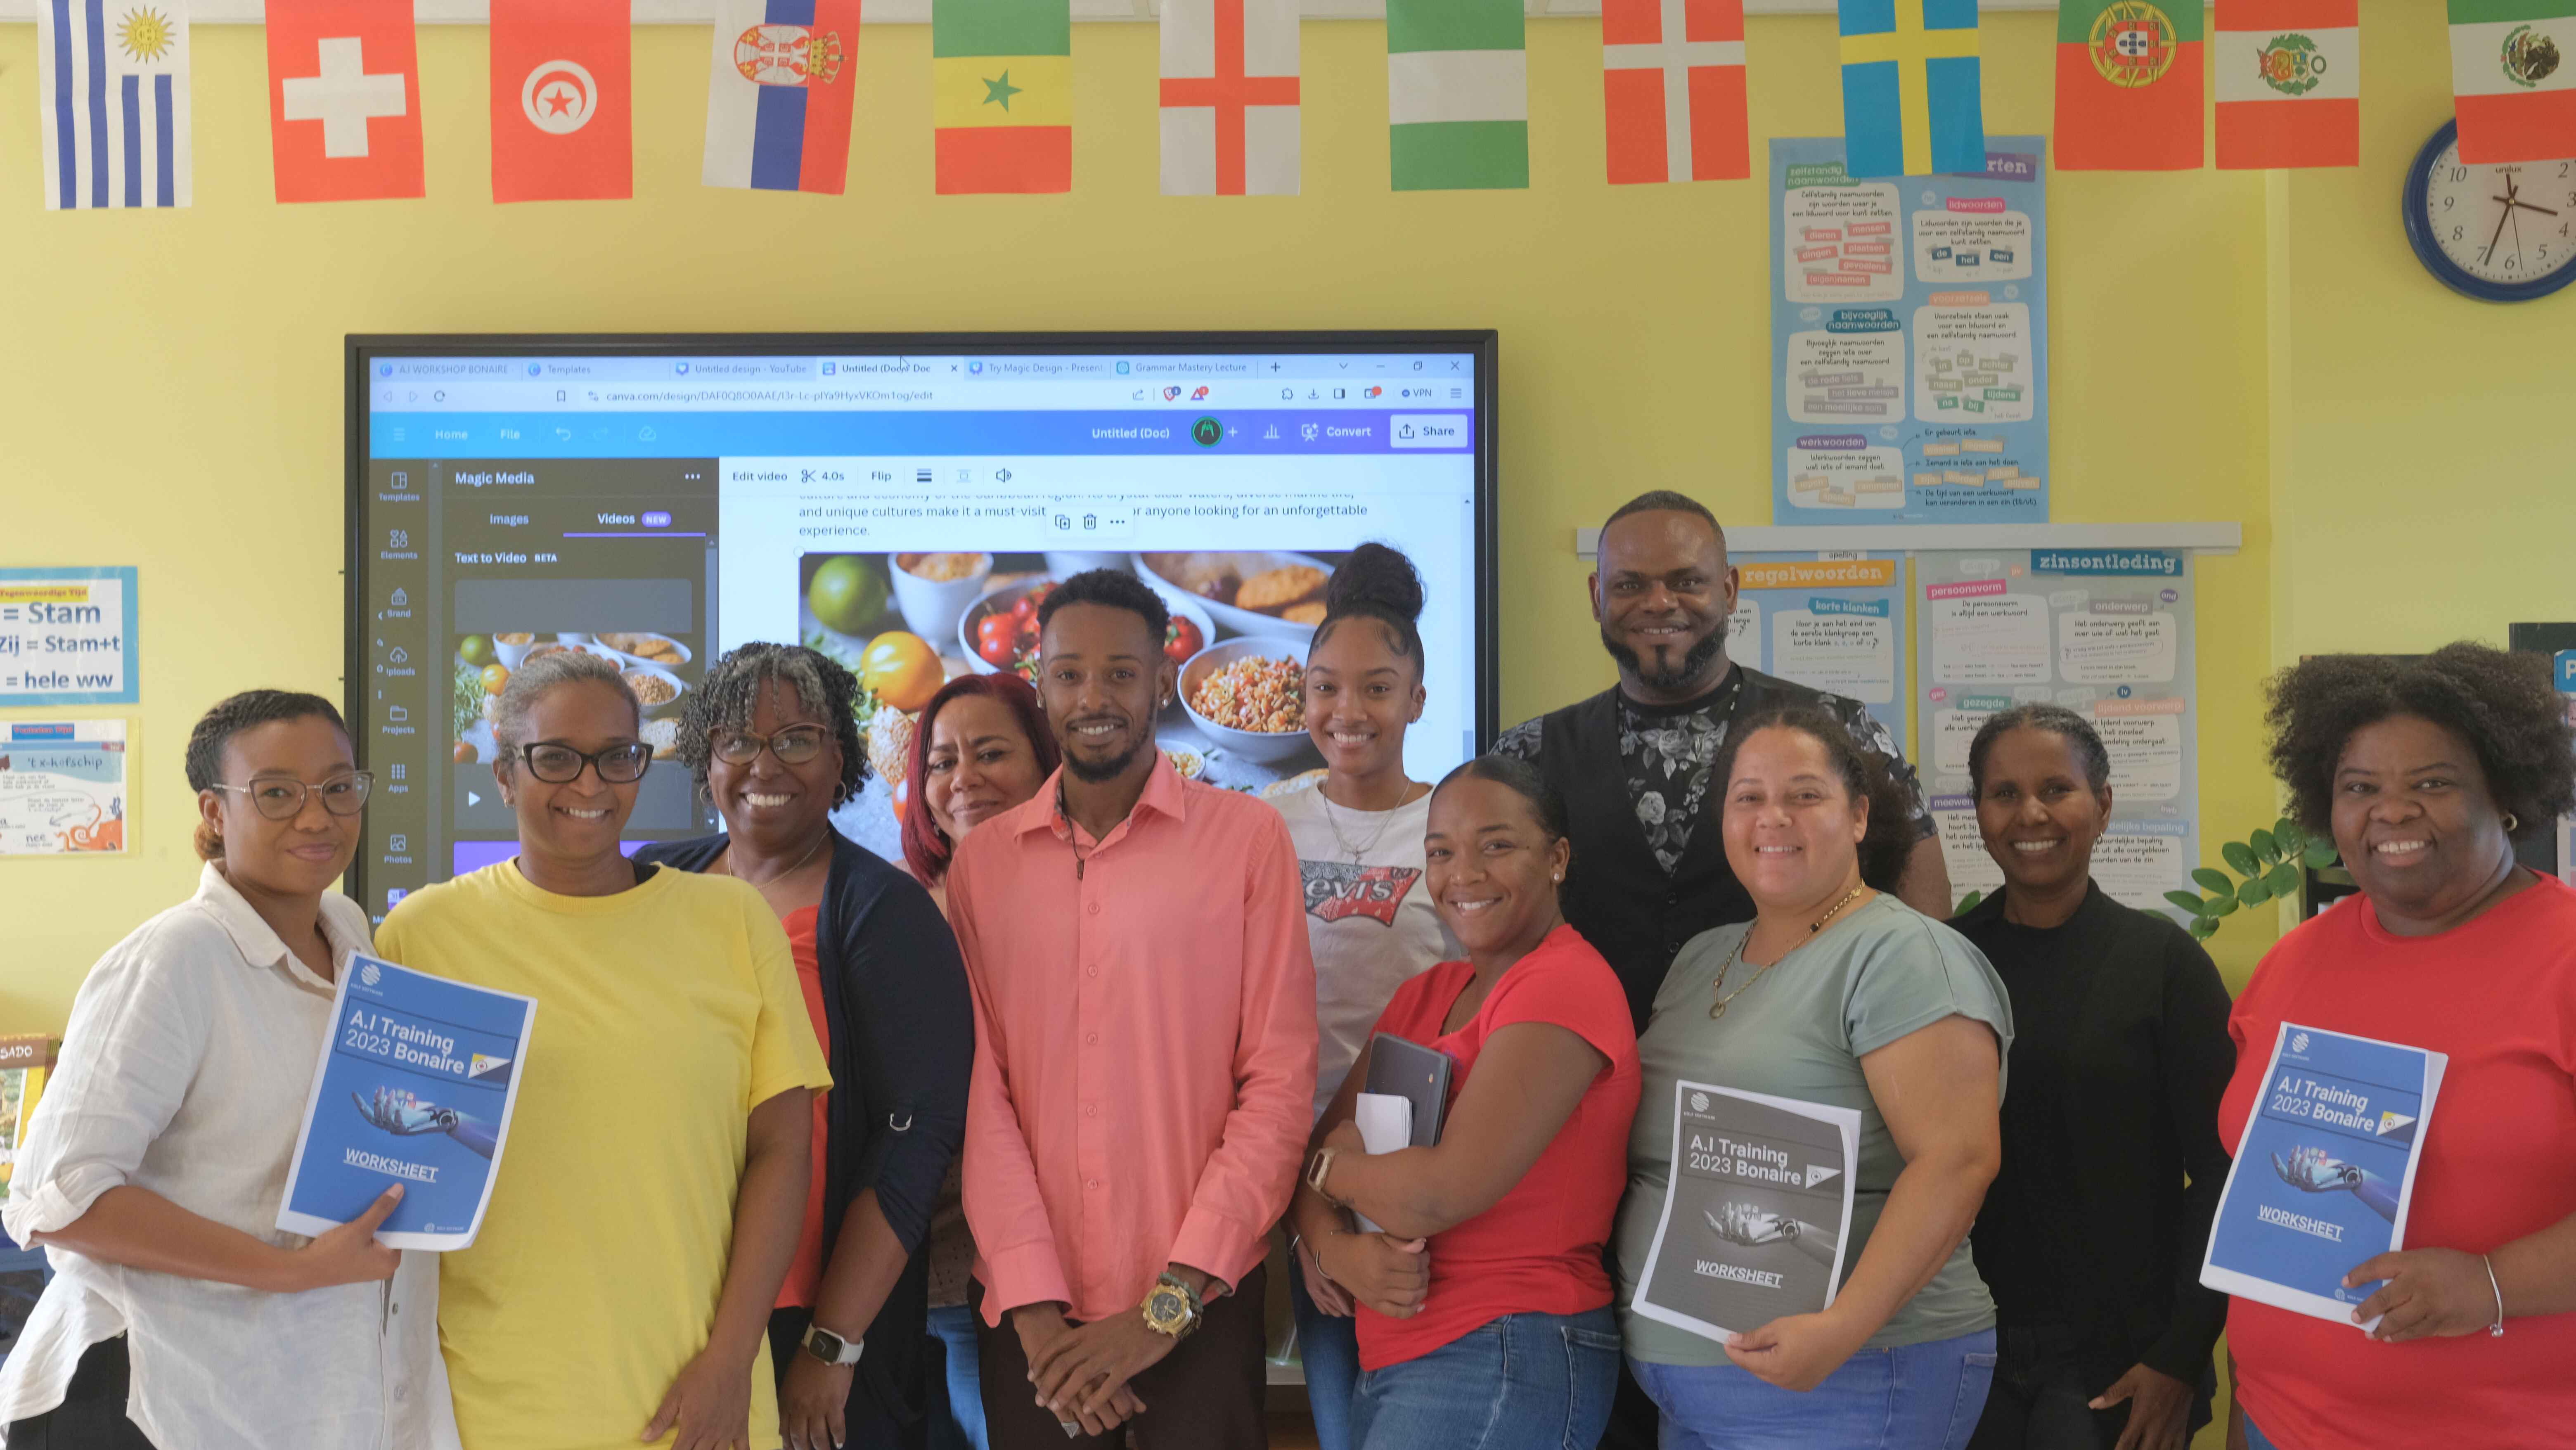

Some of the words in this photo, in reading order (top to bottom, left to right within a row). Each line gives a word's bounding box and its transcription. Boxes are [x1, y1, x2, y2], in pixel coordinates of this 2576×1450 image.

[1790, 165, 1842, 177] zelfstandig
[1987, 158, 2027, 174] rten
[2495, 165, 2522, 174] unilux
[2558, 162, 2569, 178] 2
[2449, 166, 2467, 182] 10
[1949, 199, 2003, 208] lidwoorden
[2444, 196, 2454, 212] 9
[2567, 191, 2576, 208] 3
[1853, 224, 1885, 233] mensen
[2452, 225, 2463, 241] 8
[2559, 222, 2569, 237] 4
[1802, 249, 1831, 259] dingen
[1849, 244, 1884, 252] plaatsen
[2477, 246, 2488, 262] 7
[2536, 244, 2548, 260] 5
[1994, 253, 2009, 261] een
[2504, 254, 2515, 270] 6
[1844, 262, 1886, 271] gevoelens
[1842, 311, 1888, 321] bijvoeglijk
[1829, 320, 1899, 329] naamwoorden
[413, 365, 466, 374] WORKSHOP
[469, 365, 507, 374] BONAIRE
[548, 365, 591, 375] Templates
[696, 364, 729, 374] Untitled
[732, 365, 760, 375] design
[770, 364, 806, 373] YouTube
[843, 364, 877, 373] Untitled
[914, 364, 930, 373] Doc
[990, 364, 1002, 374] Try
[1004, 364, 1030, 374] Magic
[1033, 364, 1062, 374] Design
[1136, 363, 1175, 372] Grammar
[1179, 363, 1212, 374] Mastery
[1215, 363, 1246, 372] Lecture
[1413, 388, 1432, 398] VPN
[1988, 391, 2016, 400] tijdens
[435, 430, 468, 440] Home
[500, 430, 520, 440] File
[1092, 428, 1138, 438] Untitled
[1140, 429, 1170, 440] (Doc)
[1326, 427, 1371, 437] Convert
[1423, 426, 1454, 436] Share
[1800, 438, 1864, 447] werkwoorden
[455, 472, 492, 487] Magic
[496, 472, 534, 484] Media
[733, 471, 754, 481] Edit
[757, 471, 788, 481] video
[822, 471, 844, 481] 4.0s
[871, 471, 891, 483] Flip
[379, 493, 420, 502] Templates
[799, 506, 822, 517] and
[826, 506, 868, 520] unique
[872, 506, 923, 517] cultures
[927, 506, 959, 517] make
[963, 507, 970, 517] it
[1146, 507, 1191, 519] anyone
[1194, 505, 1238, 519] looking
[1243, 505, 1259, 516] for
[1264, 507, 1278, 516] an
[1283, 505, 1367, 519] unforgettable
[490, 514, 529, 526] Images
[597, 513, 635, 524] Videos
[799, 525, 870, 538] experience.
[455, 553, 478, 563] Text
[481, 554, 492, 563] to
[495, 553, 527, 563] Video
[535, 554, 557, 562] BETA
[1829, 551, 1858, 561] spelling
[2040, 554, 2176, 573] zinsontleding
[1745, 566, 1883, 585] regelwoorden
[1932, 583, 2002, 597] persoonsvorm
[2162, 591, 2176, 601] ond
[28, 601, 101, 624] Stam
[1816, 600, 1840, 611] korte
[1843, 602, 1880, 614] klanken
[2095, 602, 2148, 613] onderwerp
[45, 634, 121, 653] Stam+t
[25, 670, 69, 689] hele
[76, 674, 114, 688] ww
[1963, 698, 2005, 708] gezegde
[382, 725, 415, 735] Projects
[388, 784, 409, 793] Apps
[2143, 821, 2184, 833] bepaling
[26, 834, 46, 843] nee
[384, 855, 412, 864] Photos
[1306, 878, 1395, 901] evi's
[351, 1010, 376, 1031] A.I
[382, 1017, 455, 1056] Training
[346, 1030, 390, 1055] 2023
[394, 1042, 464, 1074] Bonaire
[2278, 1076, 2300, 1092] A.I
[2305, 1081, 2368, 1112] Training
[2272, 1094, 2310, 1116] 2023
[2312, 1104, 2375, 1132] Bonaire
[1690, 1134, 1713, 1151] A.I
[1718, 1138, 1788, 1167] Training
[346, 1148, 439, 1181] WORKSHEET
[1690, 1153, 1731, 1174] 2023
[1736, 1161, 1802, 1186] Bonaire
[2259, 1204, 2344, 1239] WORKSHEET
[1696, 1259, 1783, 1286] WORKSHEET
